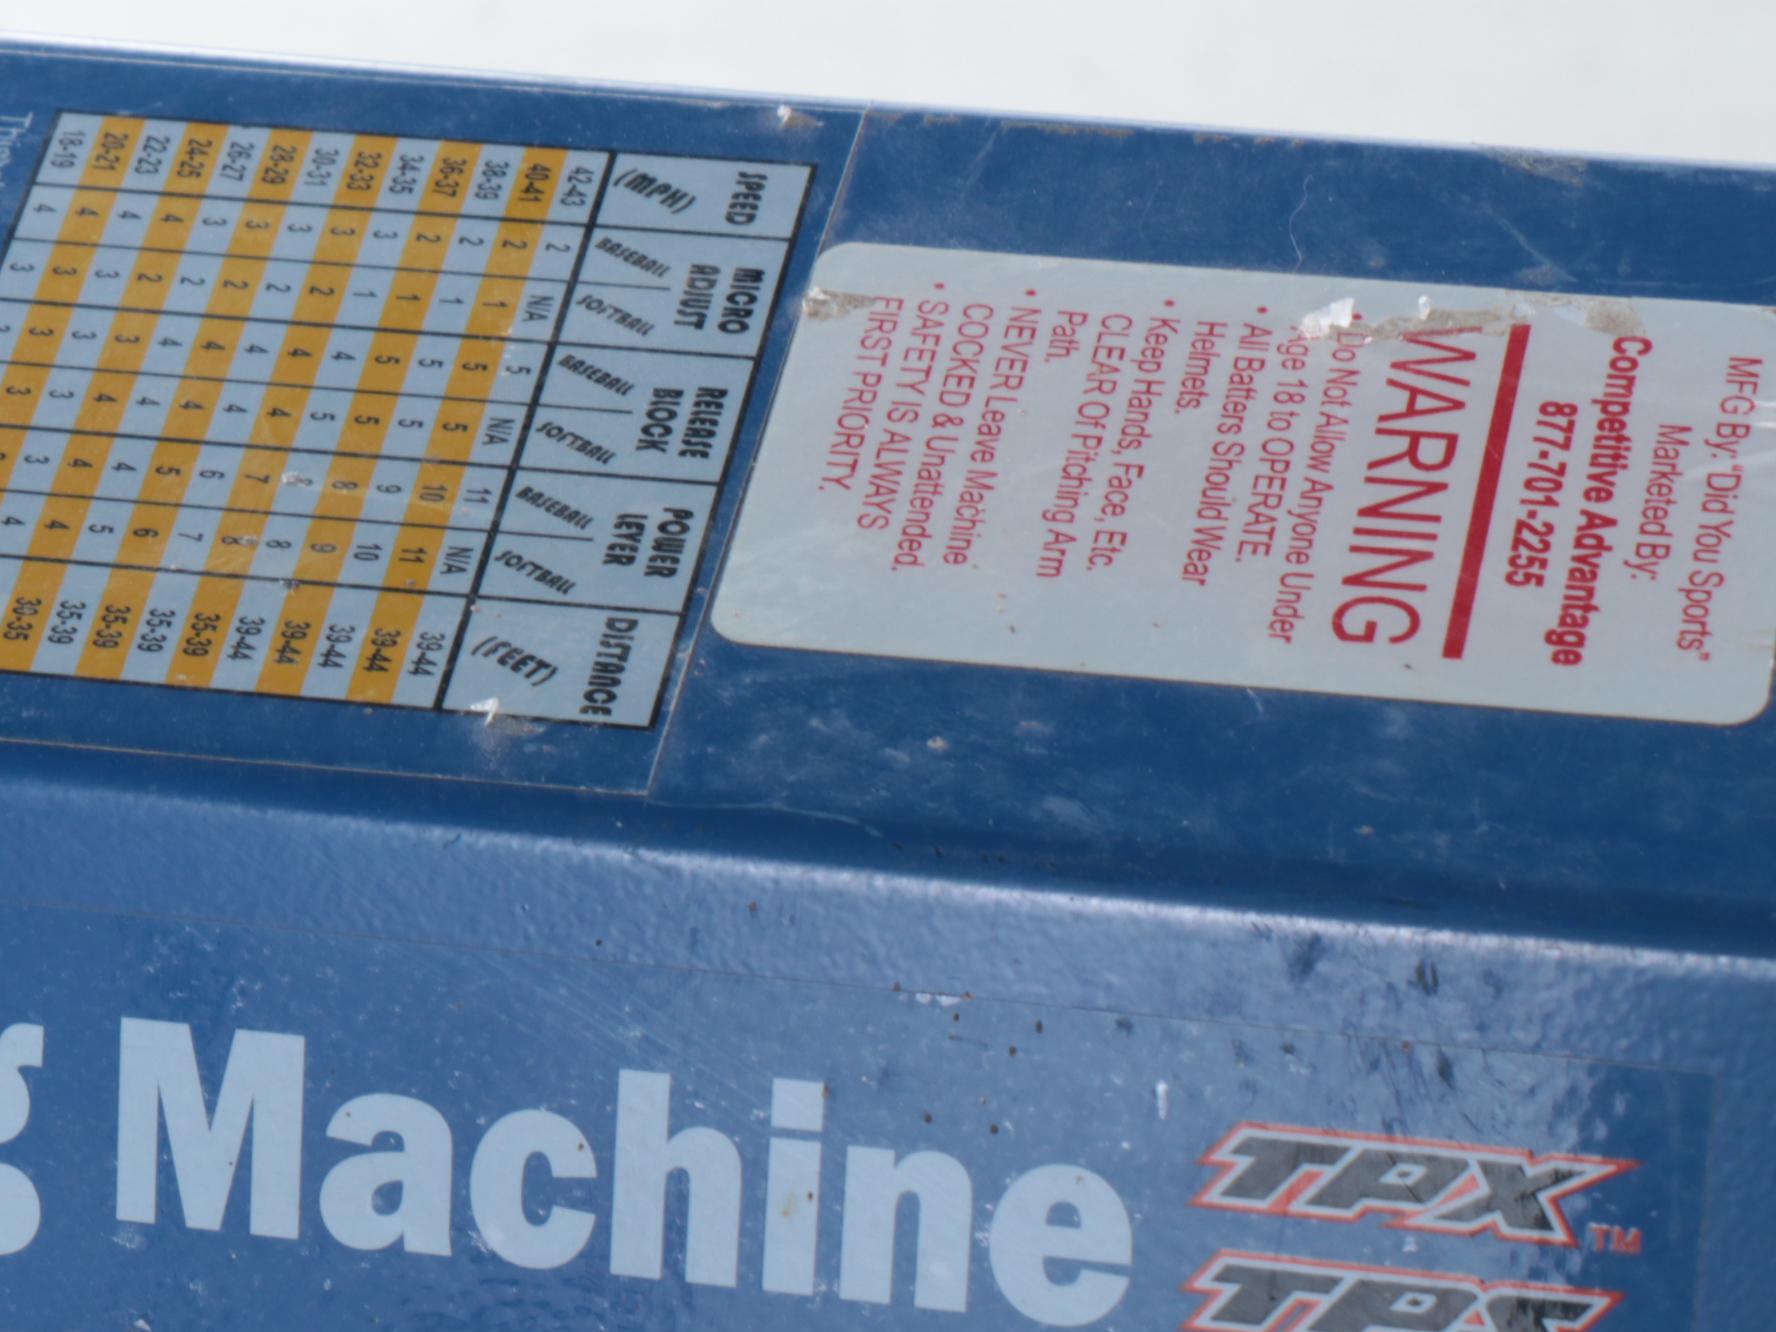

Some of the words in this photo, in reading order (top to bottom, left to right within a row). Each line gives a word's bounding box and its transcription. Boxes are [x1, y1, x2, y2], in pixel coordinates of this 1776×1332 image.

[49, 130, 86, 169] 18-19
[133, 134, 172, 175] 22-23
[175, 138, 214, 179] 24-25
[219, 141, 256, 183] 26-27
[260, 144, 298, 186] 28-29
[303, 148, 341, 187] 30-31
[345, 151, 383, 192] 32-33
[387, 154, 425, 195] 34-35
[431, 157, 468, 199] 36-37
[473, 160, 511, 201] 38-39
[517, 163, 552, 203] 40-41
[559, 166, 595, 207] 42-43
[612, 169, 696, 214] (MPH)
[724, 171, 768, 226] SPEED
[594, 237, 671, 278] BASEBALL
[575, 294, 655, 337] SOFTBALL
[673, 263, 721, 331] ADJUST
[717, 267, 766, 335] MICRO
[857, 294, 906, 368] FIRST
[896, 300, 950, 396] SAFETY
[937, 303, 996, 409] COCKED
[990, 307, 1042, 391] NEVER
[1045, 309, 1090, 361] Path.
[1083, 312, 1135, 397] CLEAR
[1131, 317, 1180, 375] Keep
[1239, 322, 1274, 352] All
[557, 354, 635, 397] BASEBALL
[1175, 321, 1228, 412] Helmets.
[1272, 378, 1308, 405] 18
[1321, 367, 1361, 409] Not
[1718, 356, 1765, 417] MFG
[635, 387, 685, 453] BLOCK
[885, 400, 923, 426] IS
[931, 411, 965, 430] &
[1076, 400, 1113, 431] Of
[1112, 377, 1165, 456] Hands,
[1216, 355, 1267, 436] Batters
[1265, 410, 1301, 433] to
[1583, 336, 1654, 505] Competitive
[535, 421, 616, 466] SOFTBALL
[677, 386, 729, 459] RELEASE
[819, 370, 885, 492] PRIORITY.
[969, 394, 1018, 464] Leave
[1306, 411, 1351, 474] Allow
[1705, 421, 1753, 460] By:
[856, 428, 913, 530] ALWAYS
[892, 434, 960, 570] Unattended.
[1041, 433, 1105, 525] Pitching
[1098, 461, 1146, 523] Face,
[1196, 440, 1247, 521] Should
[1235, 436, 1297, 561] OPERATE.
[1331, 327, 1480, 645] WARNING
[1505, 400, 1580, 588] 877-701-2255
[1638, 423, 1694, 539] Marketed
[1700, 463, 1745, 516] “Did
[515, 485, 594, 531] BASEBALL
[942, 468, 1000, 566] Machine
[1284, 476, 1335, 566] Anyone
[602, 513, 648, 567] LEVER
[643, 507, 695, 579] POWER
[1037, 527, 1079, 579] Arm
[1088, 528, 1130, 570] Etc.
[1183, 525, 1227, 587] Wear
[1623, 541, 1673, 581] By:
[1691, 519, 1735, 565] You
[493, 550, 576, 596] SOFTBALL
[1544, 508, 1619, 667] Advantage
[2, 596, 43, 642] 30-35
[46, 600, 87, 645] 35-39
[91, 604, 132, 649] 35-39
[136, 608, 177, 653] 35-39
[1267, 571, 1316, 645] Under
[1676, 568, 1727, 662] Sports”
[181, 612, 222, 658] 35-39
[227, 616, 266, 661] 39-44
[275, 620, 312, 665] 39-44
[317, 624, 356, 669] 39-44
[362, 628, 402, 673] 39-44
[408, 632, 446, 676] 39-44
[470, 636, 559, 687] (FEET)
[579, 617, 639, 716] DISTANCE
[114, 1015, 1134, 1328] Machine
[1189, 1120, 1644, 1249] TPX
